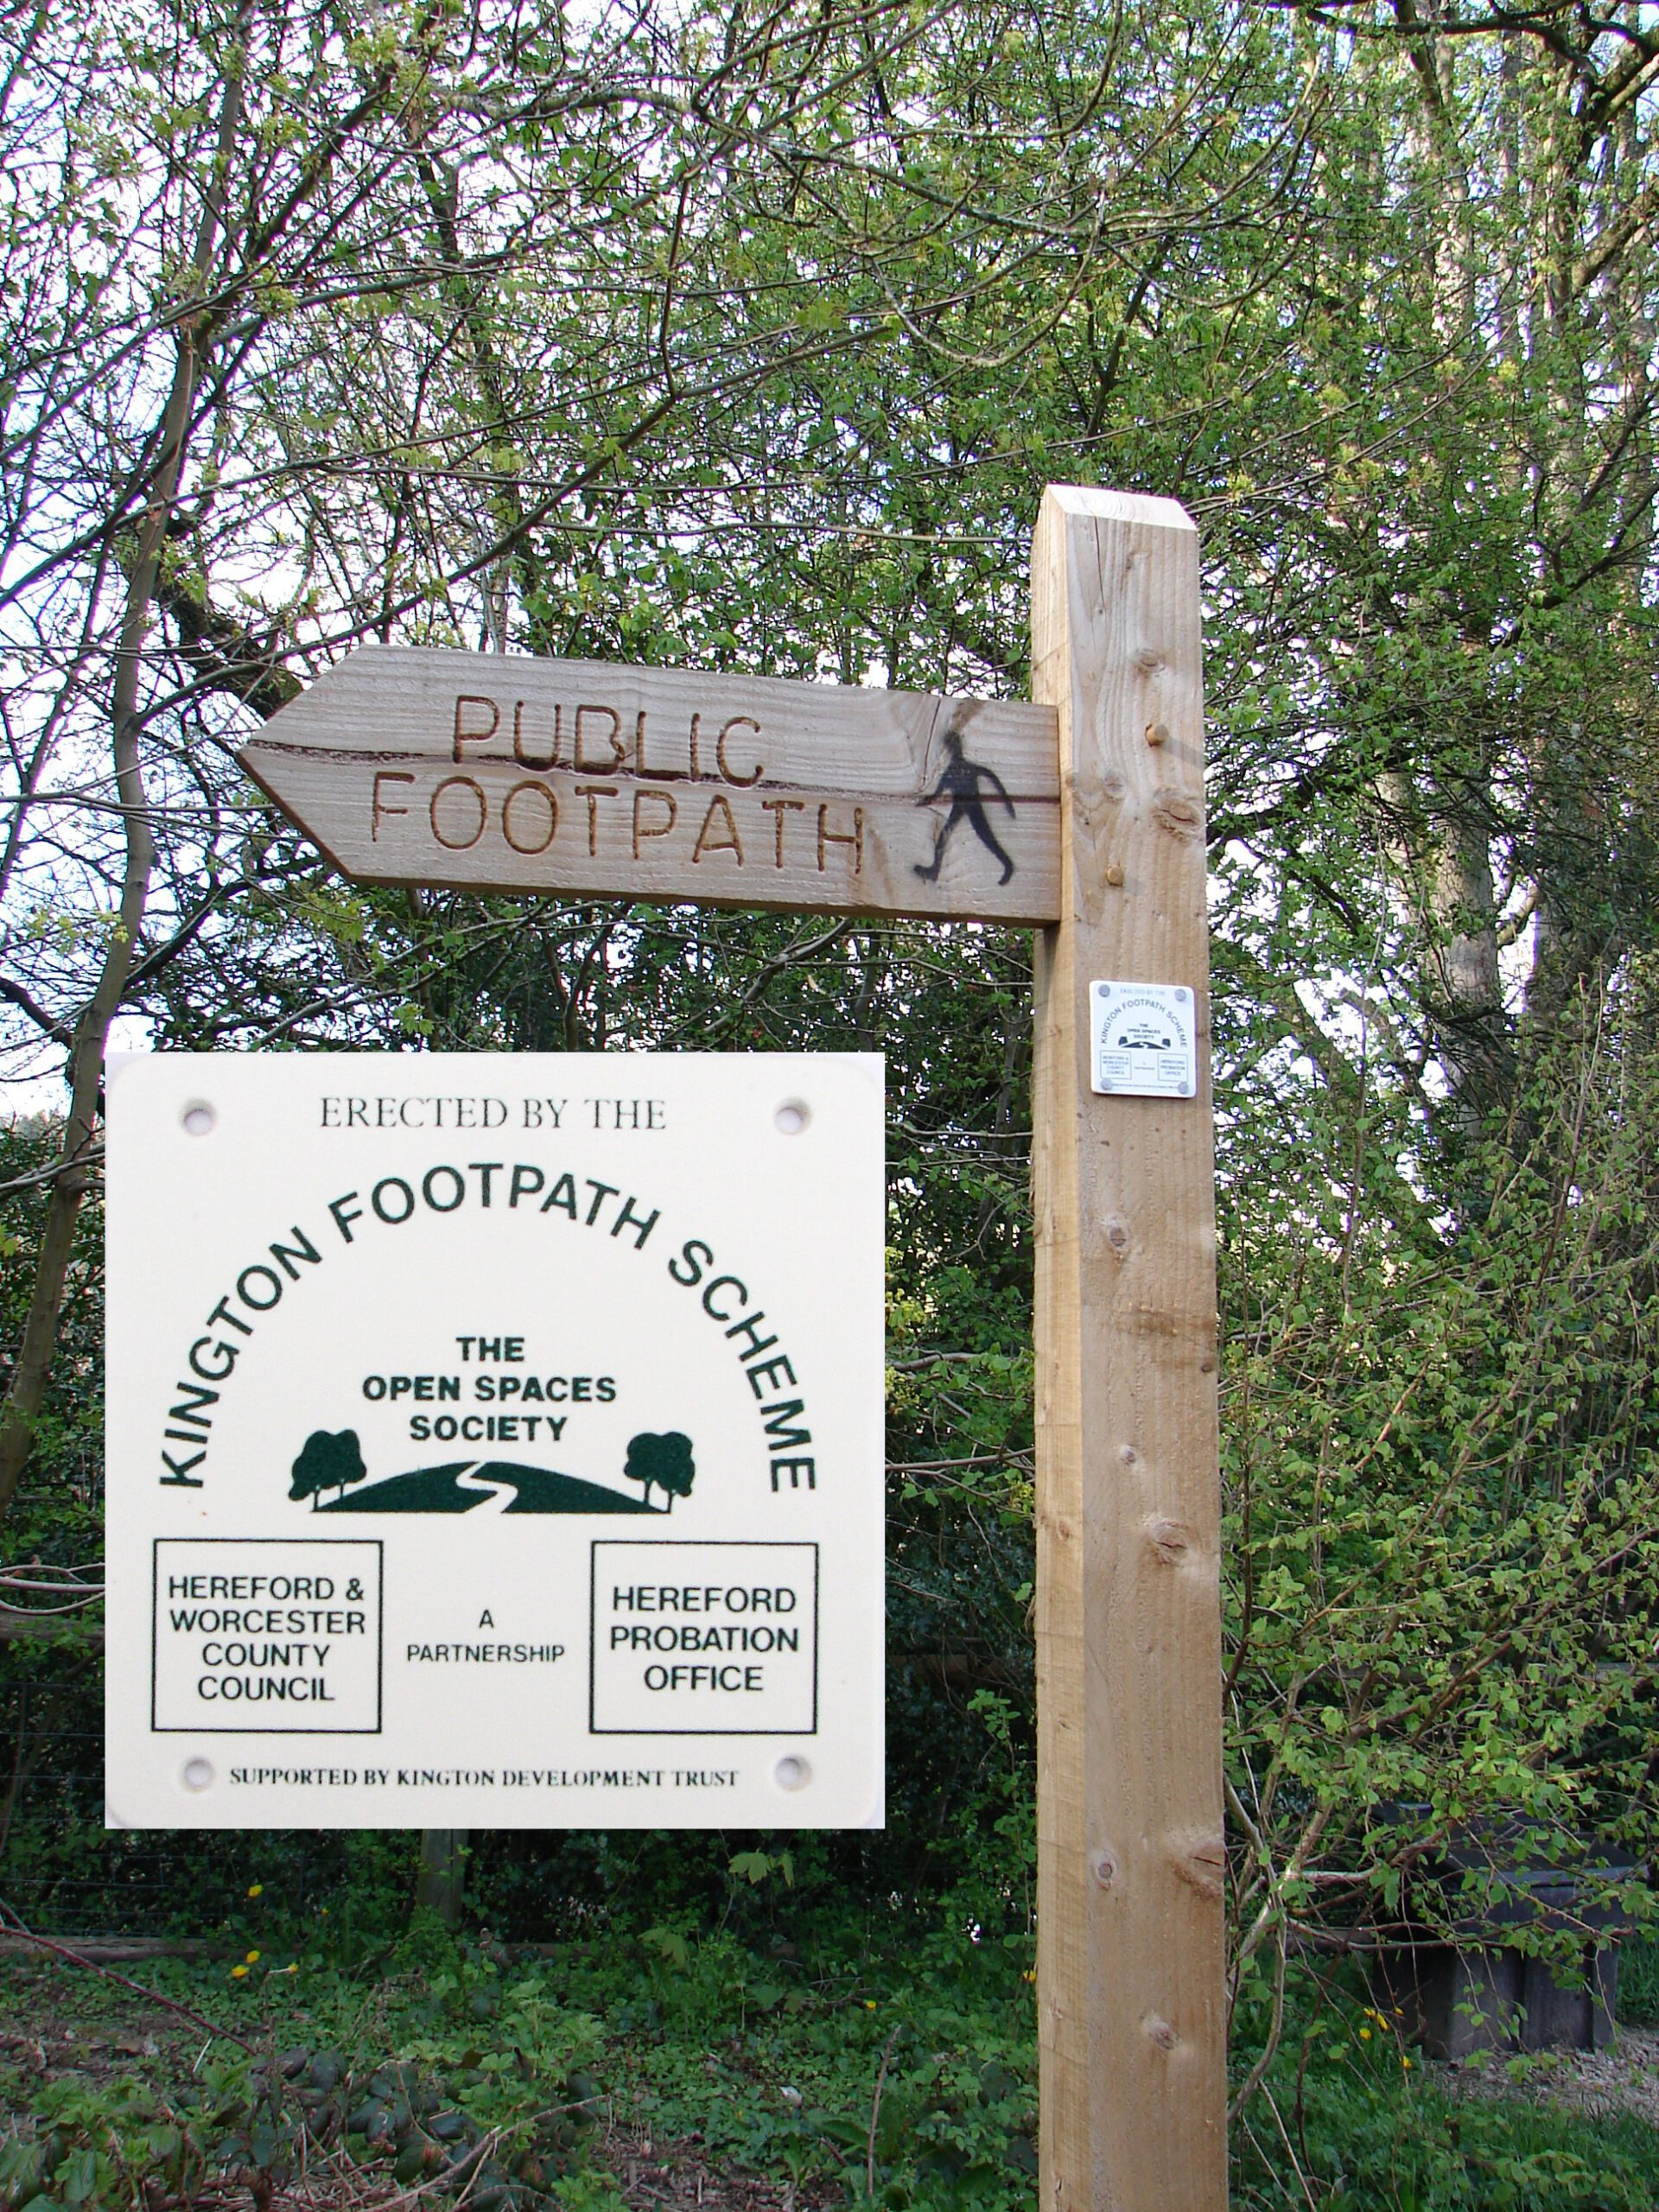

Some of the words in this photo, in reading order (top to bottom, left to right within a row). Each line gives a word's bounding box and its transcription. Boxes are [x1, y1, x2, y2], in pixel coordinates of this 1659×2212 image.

[454, 696, 763, 787] PUBLIC
[372, 772, 863, 873] FOOTPATH
[1100, 1007, 1122, 1044] KINGTON
[1122, 999, 1166, 1013] FOOTPATH
[1166, 1011, 1187, 1048] SCHEME
[320, 1098, 507, 1127] ERECTED
[524, 1099, 567, 1128] BY
[585, 1100, 665, 1128] THE
[159, 1226, 323, 1489] KINGTON
[328, 1163, 660, 1249] FOOTPATH
[668, 1240, 816, 1493] SCHEME
[456, 1337, 524, 1362] THE
[362, 1376, 460, 1401] OPEN
[474, 1376, 616, 1402] SPACES
[410, 1415, 567, 1441] SOCIETY
[169, 1576, 334, 1599] HEREFORD
[346, 1578, 364, 1601] &
[613, 1586, 796, 1612] HEREFORD
[170, 1610, 365, 1634] WORCESTER
[480, 1609, 493, 1628] A
[611, 1626, 798, 1652] PROBATION
[202, 1643, 330, 1667] COUNTY
[408, 1644, 564, 1662] PARTNERSHIP
[198, 1675, 334, 1701] COUNCIL
[644, 1665, 763, 1691] OFFICE
[229, 1769, 357, 1785] SUPPORTED
[365, 1770, 389, 1785] BY
[397, 1770, 493, 1785] KINGTON
[503, 1770, 664, 1786] DEVELOPMENT
[672, 1770, 739, 1787] TRUST
